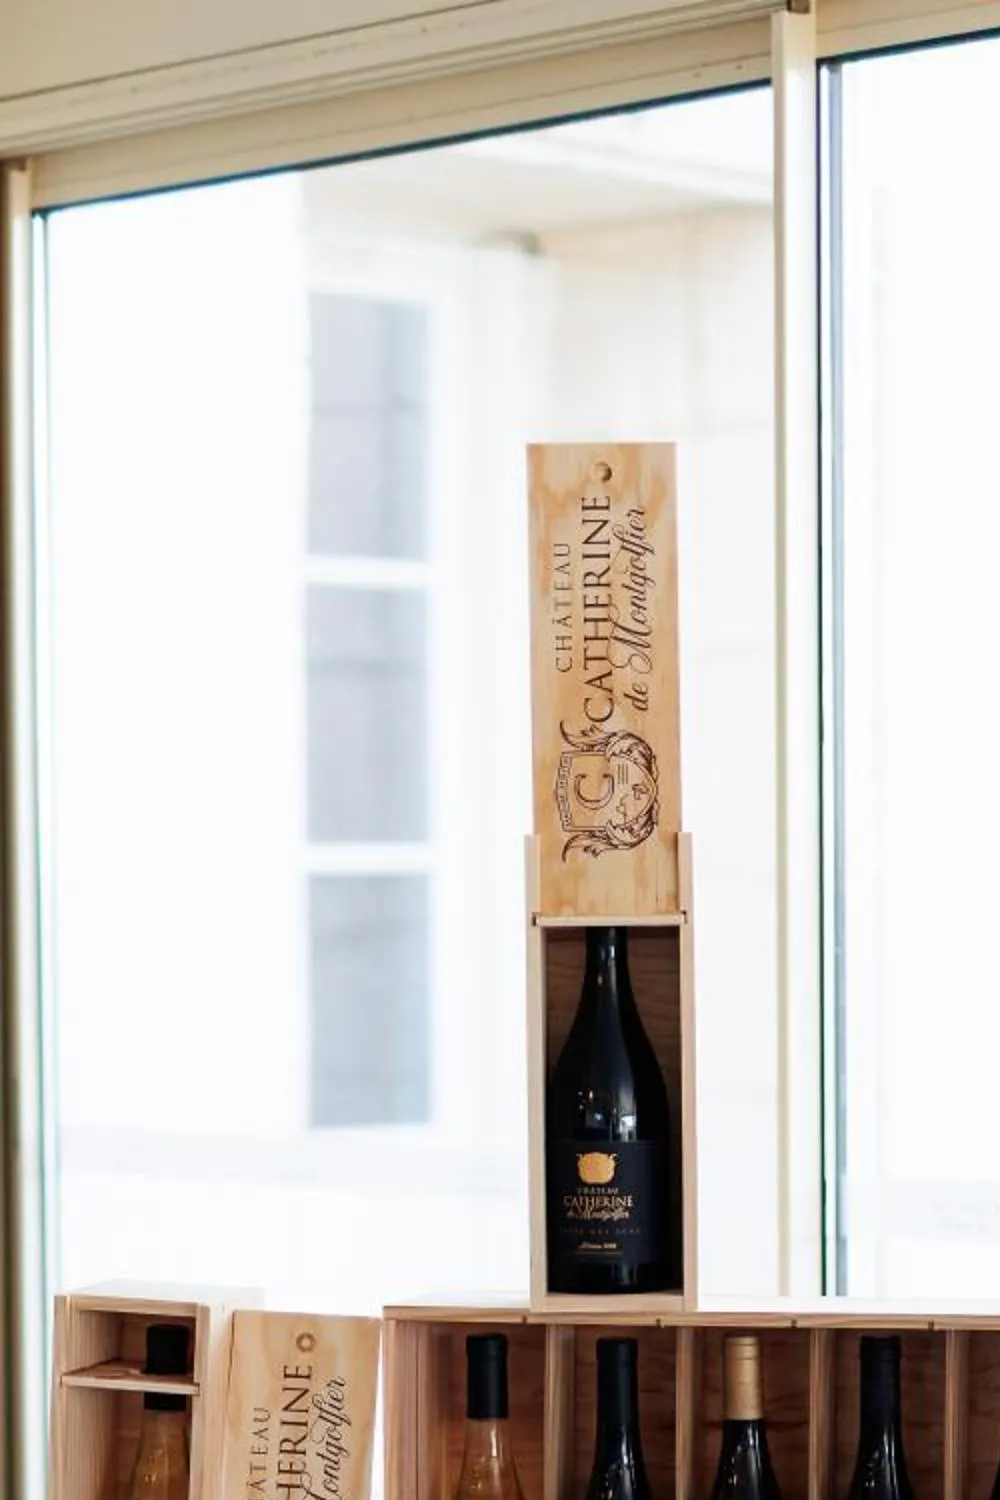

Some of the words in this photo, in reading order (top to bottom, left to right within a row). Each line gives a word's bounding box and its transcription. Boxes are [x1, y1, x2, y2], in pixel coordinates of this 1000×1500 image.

[552, 542, 574, 674] CHÂTEAU
[580, 495, 615, 724] CATHERINE
[610, 504, 657, 677] Montgolfier
[621, 684, 649, 712] de
